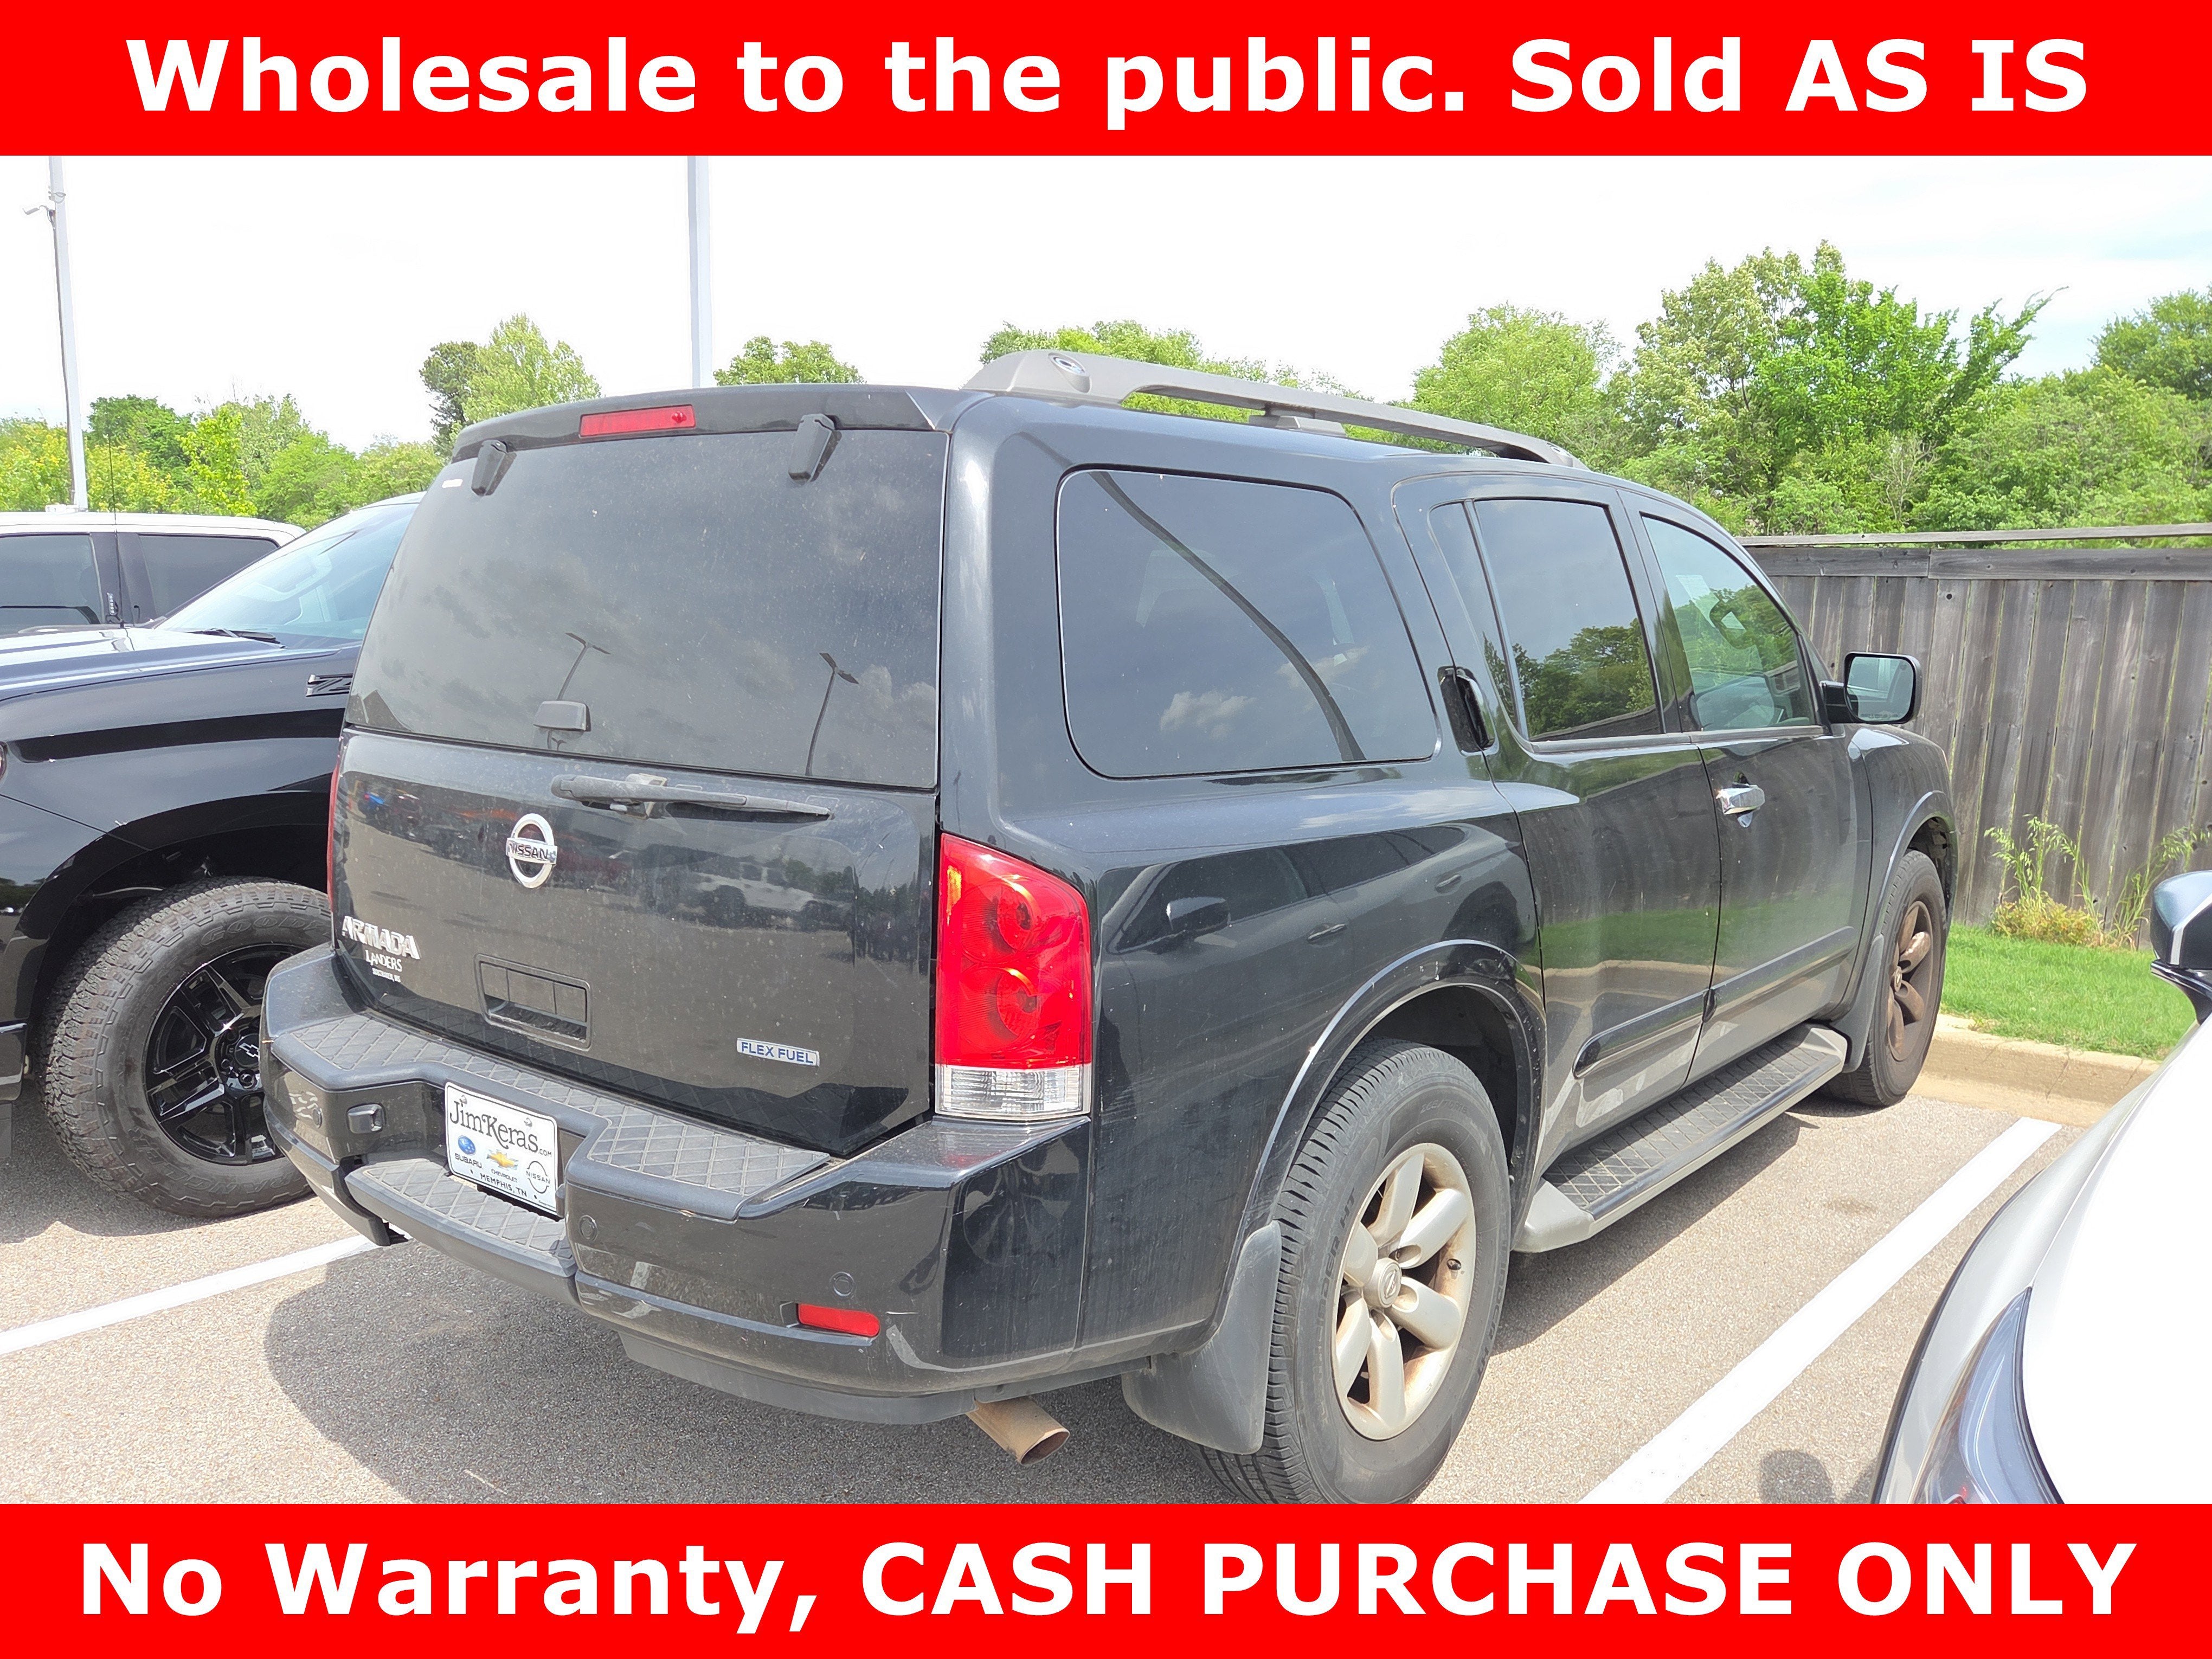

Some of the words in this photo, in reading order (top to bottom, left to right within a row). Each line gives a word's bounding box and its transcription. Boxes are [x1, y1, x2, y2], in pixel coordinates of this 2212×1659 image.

[509, 843, 548, 860] NISSAN
[342, 915, 420, 960] ARMADA
[365, 949, 402, 972] LANDERS
[741, 1041, 774, 1057] FLEX
[778, 1048, 813, 1064] FUEL
[454, 1153, 483, 1169] SUBARU
[480, 1173, 516, 1193] MEMPHIS,
[516, 1187, 528, 1198] TN
[491, 1169, 518, 1183] CHEVROLET
[525, 1170, 550, 1185] NISSAN
